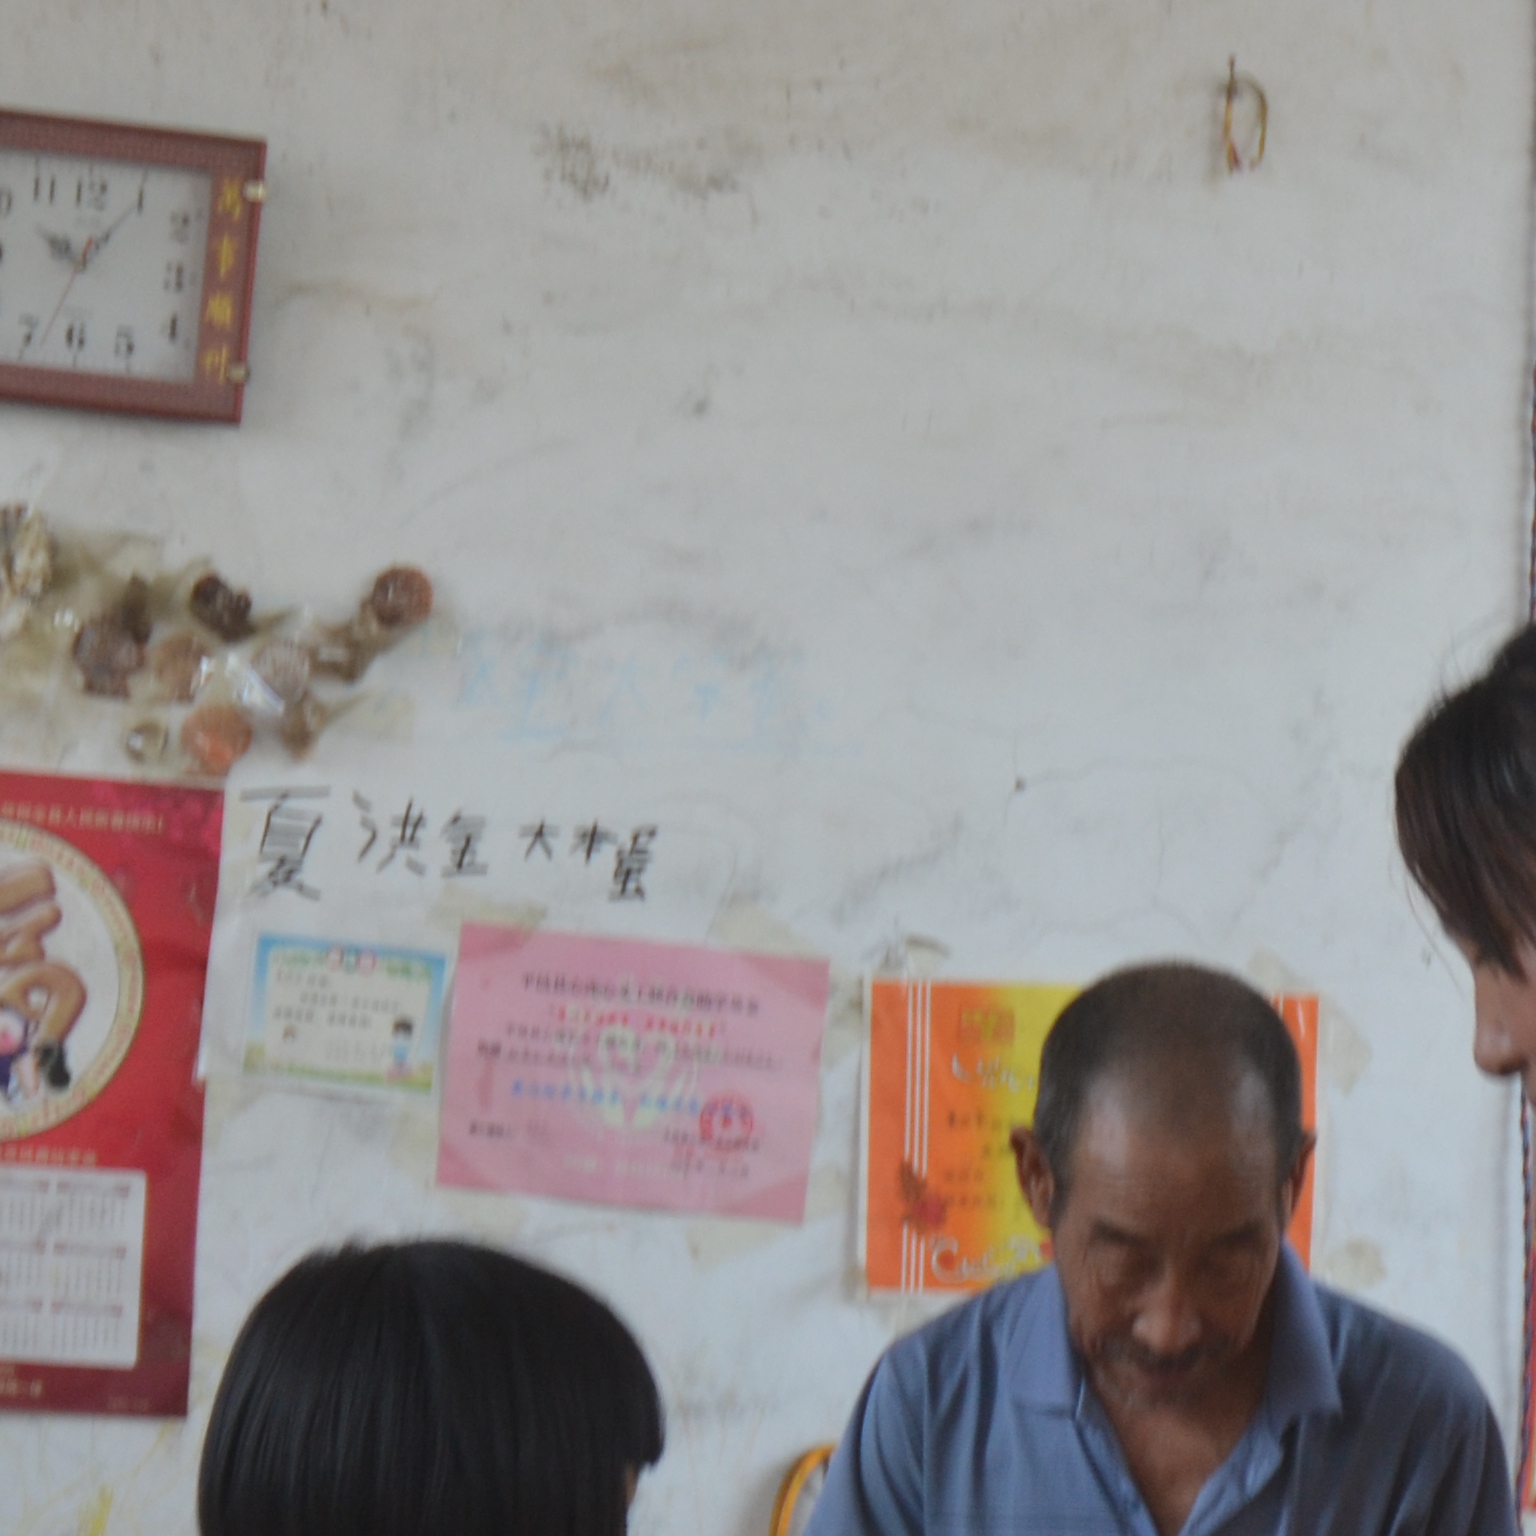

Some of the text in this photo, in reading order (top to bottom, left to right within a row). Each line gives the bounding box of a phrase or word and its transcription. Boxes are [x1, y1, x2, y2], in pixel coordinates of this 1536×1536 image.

[32, 174, 56, 206] 11
[75, 177, 109, 211] 12
[168, 209, 191, 244] 2
[165, 259, 185, 294] 3
[19, 313, 40, 348] 7
[66, 320, 85, 352] 6
[114, 323, 135, 359] 5
